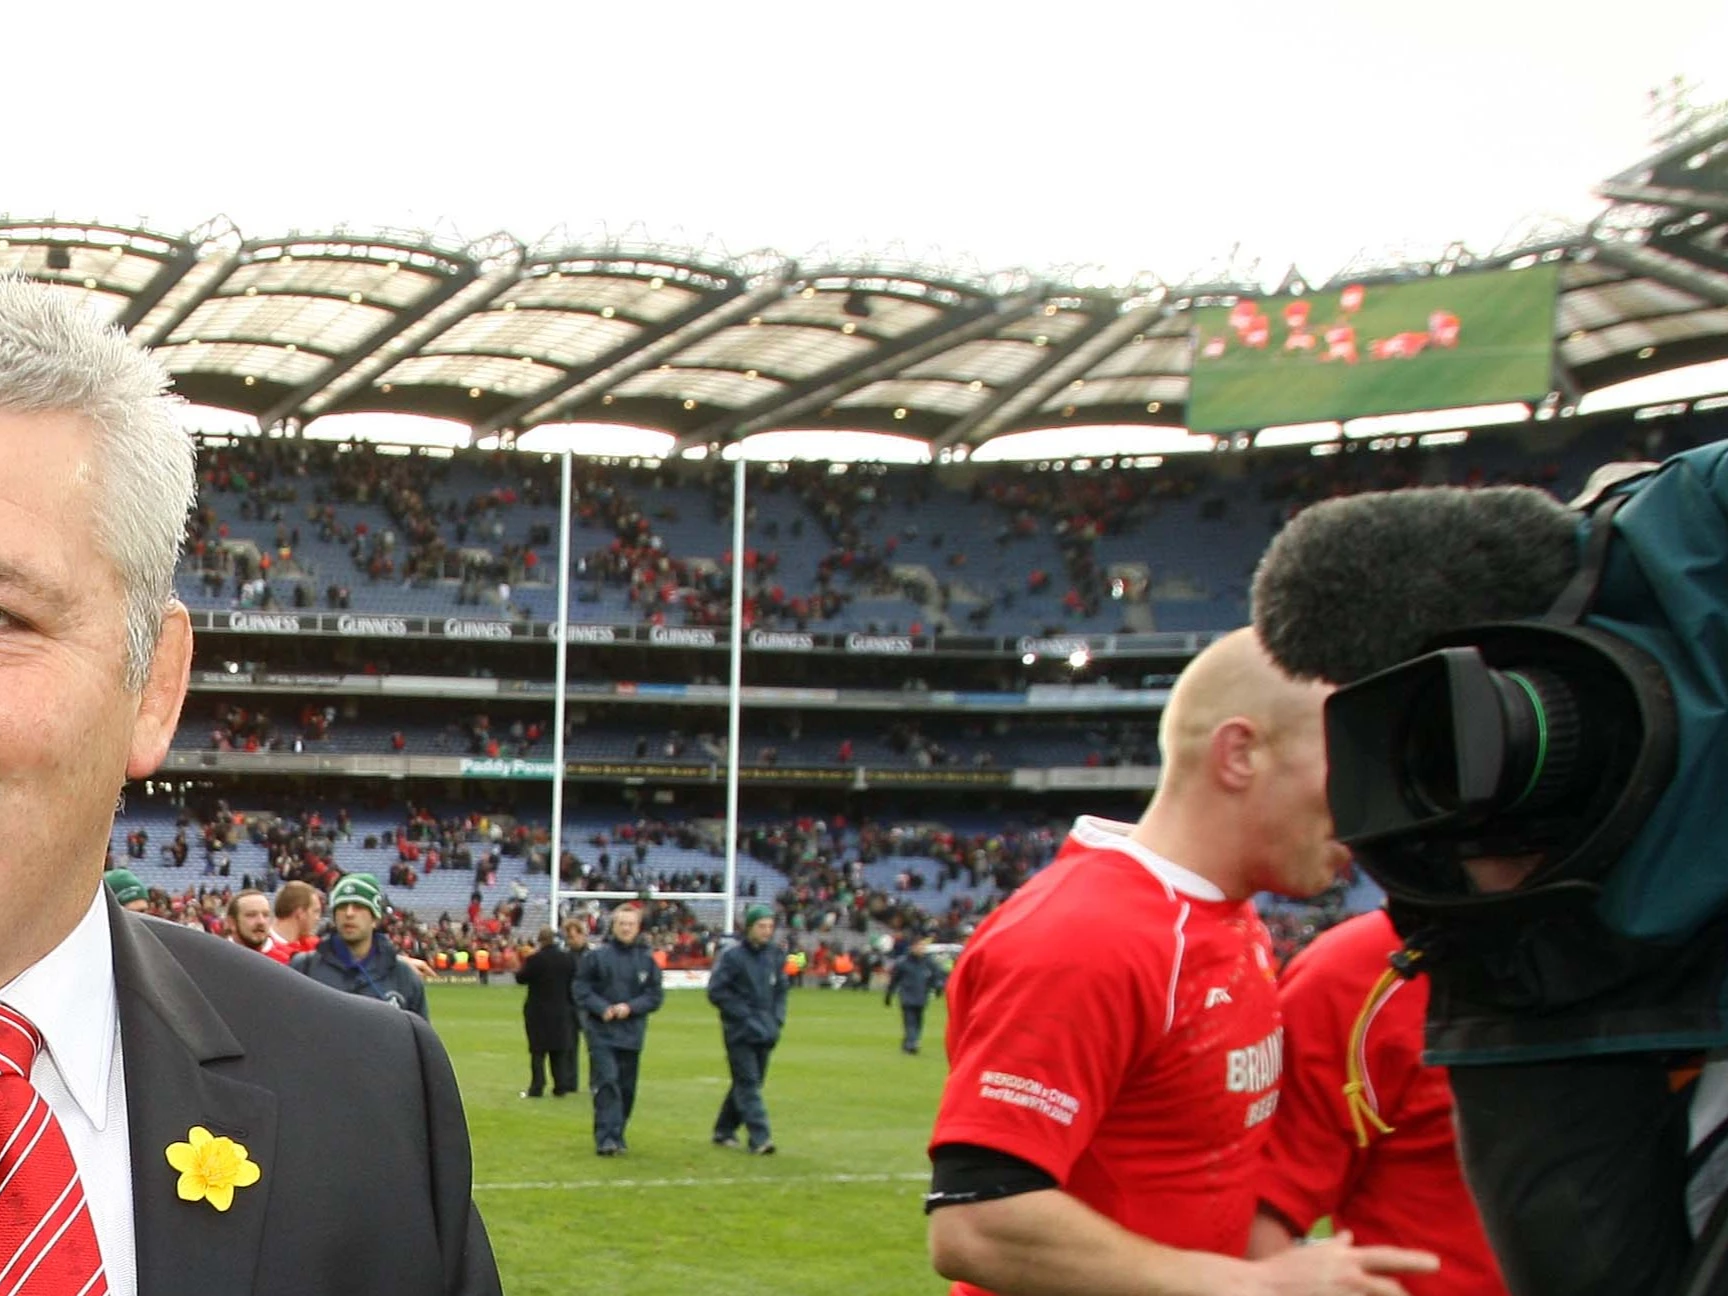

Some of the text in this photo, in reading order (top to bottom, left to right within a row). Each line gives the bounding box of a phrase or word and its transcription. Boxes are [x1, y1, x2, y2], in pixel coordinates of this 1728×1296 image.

[229, 611, 300, 633] GUINNESS
[337, 614, 408, 637] GUINNESS
[443, 617, 513, 640] GUINNESS
[548, 622, 615, 643] GINNESS
[649, 625, 716, 647] GUINNESS
[748, 629, 814, 650] GUINNESS
[1226, 1026, 1284, 1093] BRAIN
